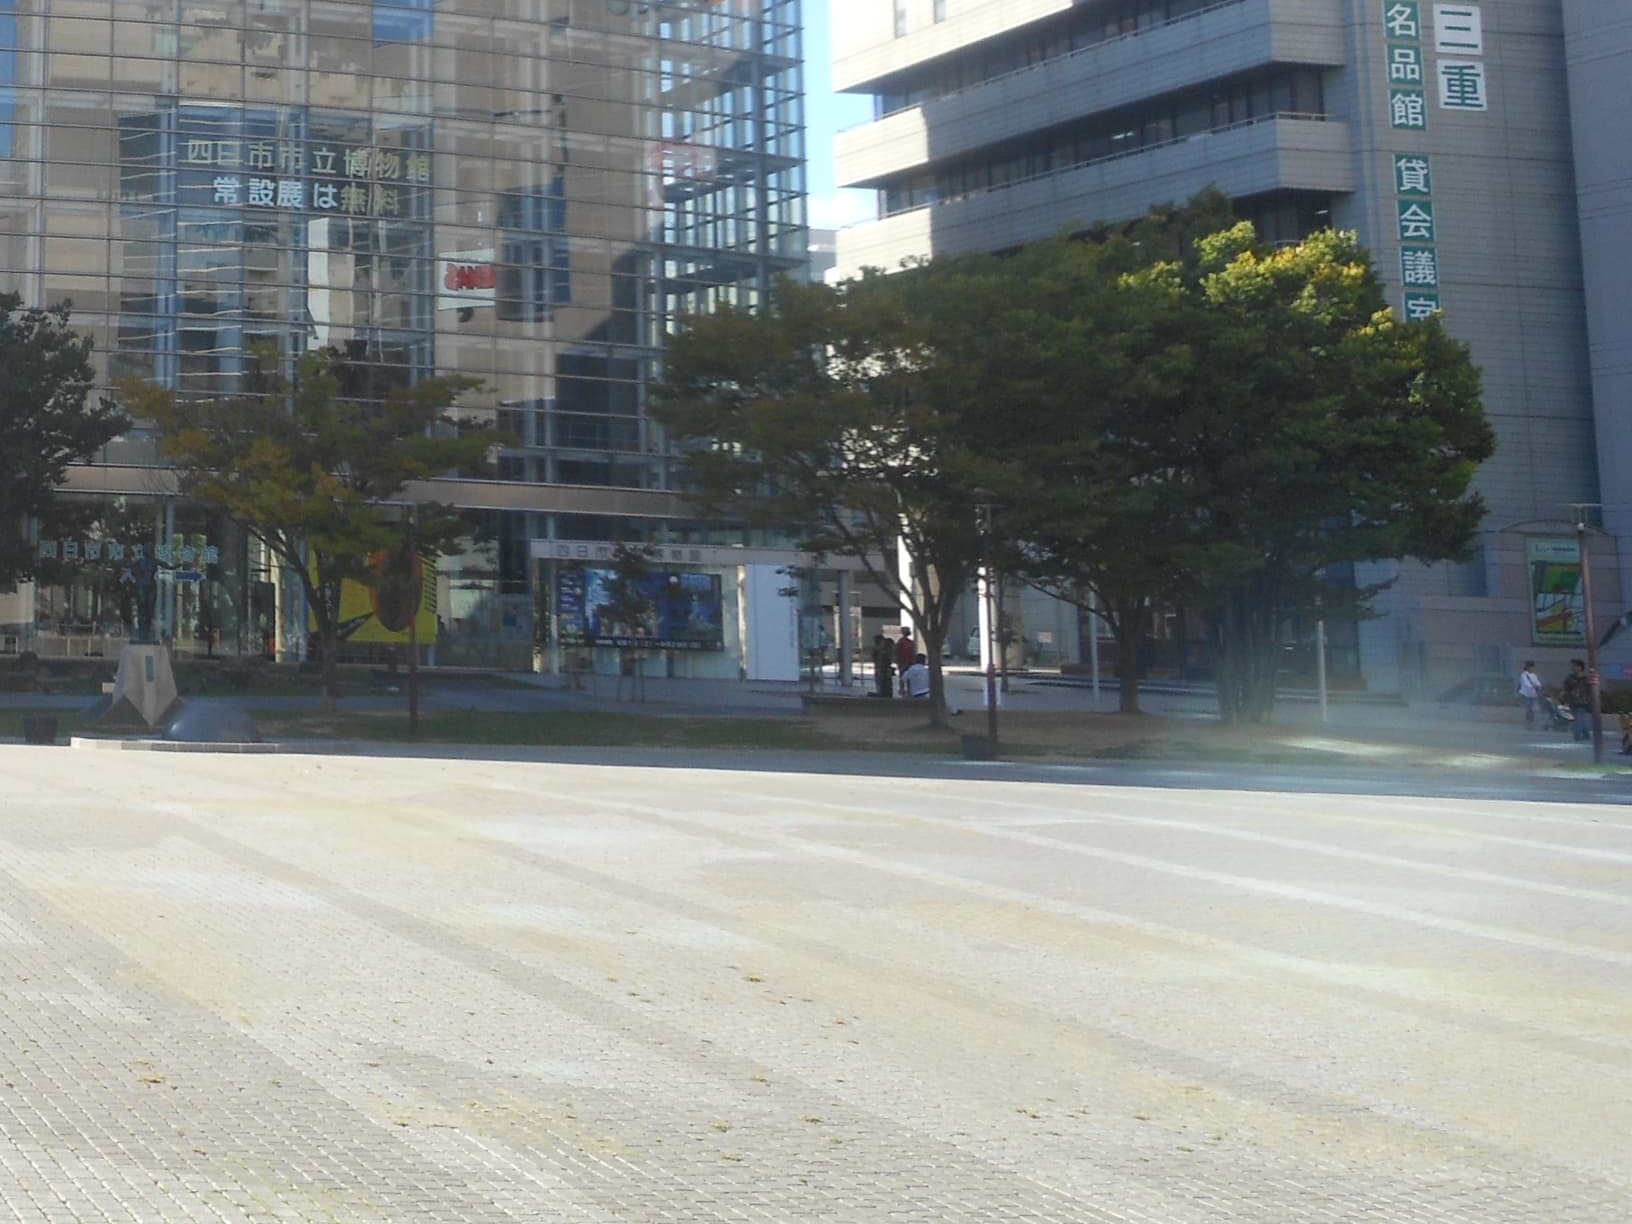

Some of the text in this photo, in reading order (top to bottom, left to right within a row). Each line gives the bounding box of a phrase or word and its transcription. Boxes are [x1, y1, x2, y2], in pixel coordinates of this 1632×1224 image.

[187, 139, 431, 182] 四日市市立博物館
[213, 177, 401, 215] 常設展は無料
